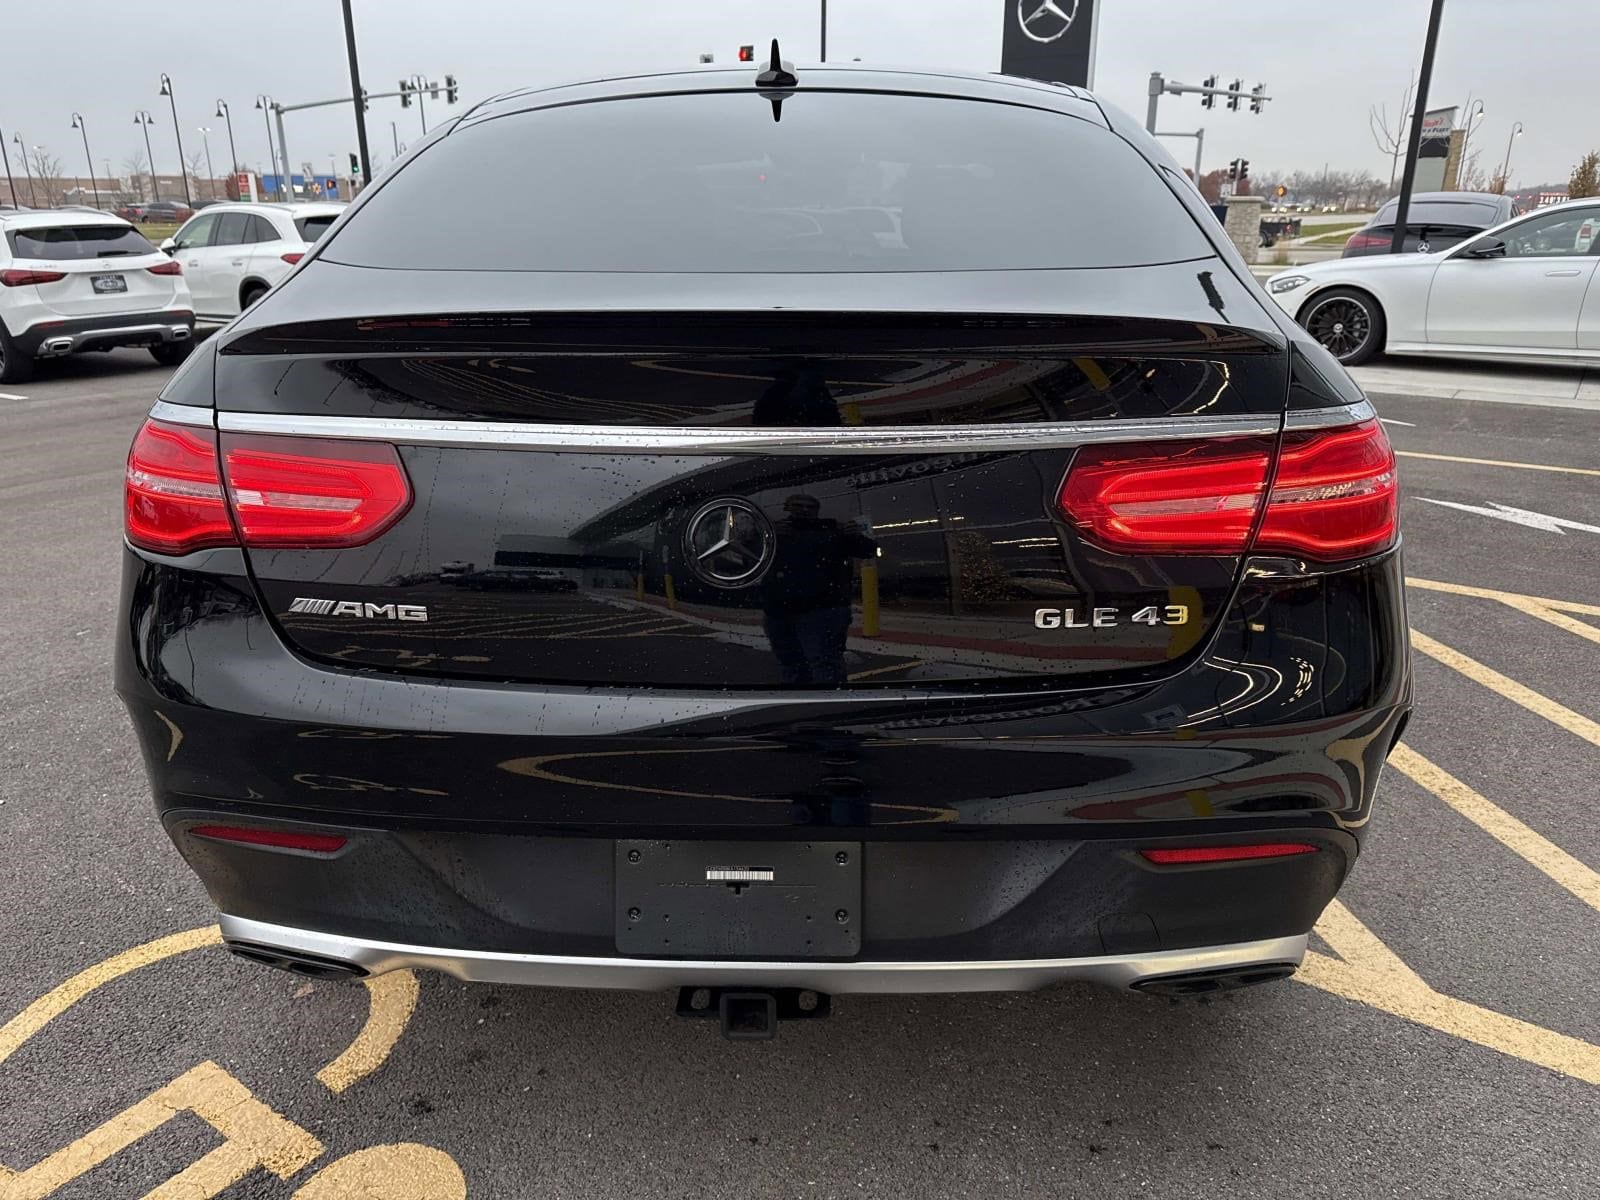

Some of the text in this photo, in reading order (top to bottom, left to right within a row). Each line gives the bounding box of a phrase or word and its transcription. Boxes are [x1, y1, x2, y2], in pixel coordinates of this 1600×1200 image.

[332, 601, 428, 622] AMG
[1034, 605, 1189, 629] GLE 43
